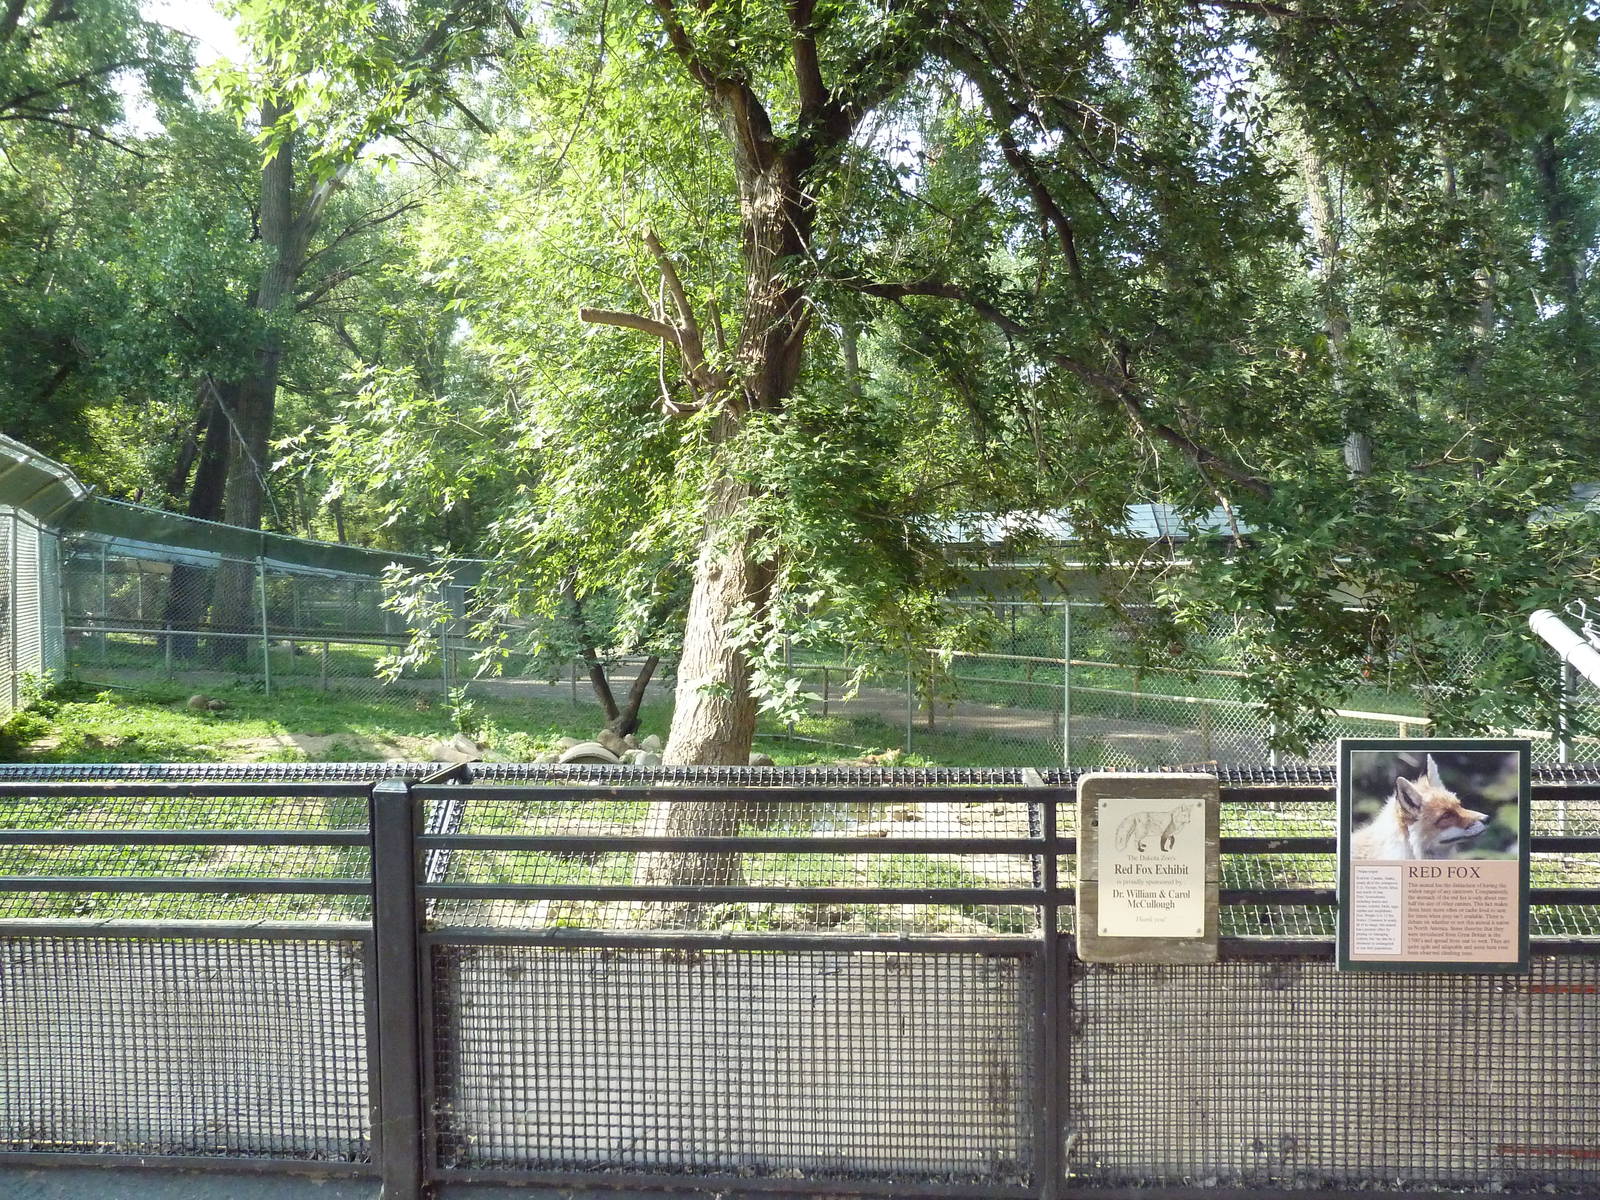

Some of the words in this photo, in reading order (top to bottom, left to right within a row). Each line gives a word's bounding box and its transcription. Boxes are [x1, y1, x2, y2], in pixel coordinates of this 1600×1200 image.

[1114, 864, 1133, 875] Red
[1136, 864, 1153, 875] Fox
[1155, 864, 1188, 875] Exhibit
[1408, 866, 1442, 878] RED
[1447, 866, 1480, 878] FOX
[1112, 889, 1125, 898] Dr.
[1126, 889, 1157, 899] William
[1159, 889, 1166, 899] &
[1168, 889, 1191, 899] Carol
[1128, 899, 1175, 910] McCullough
